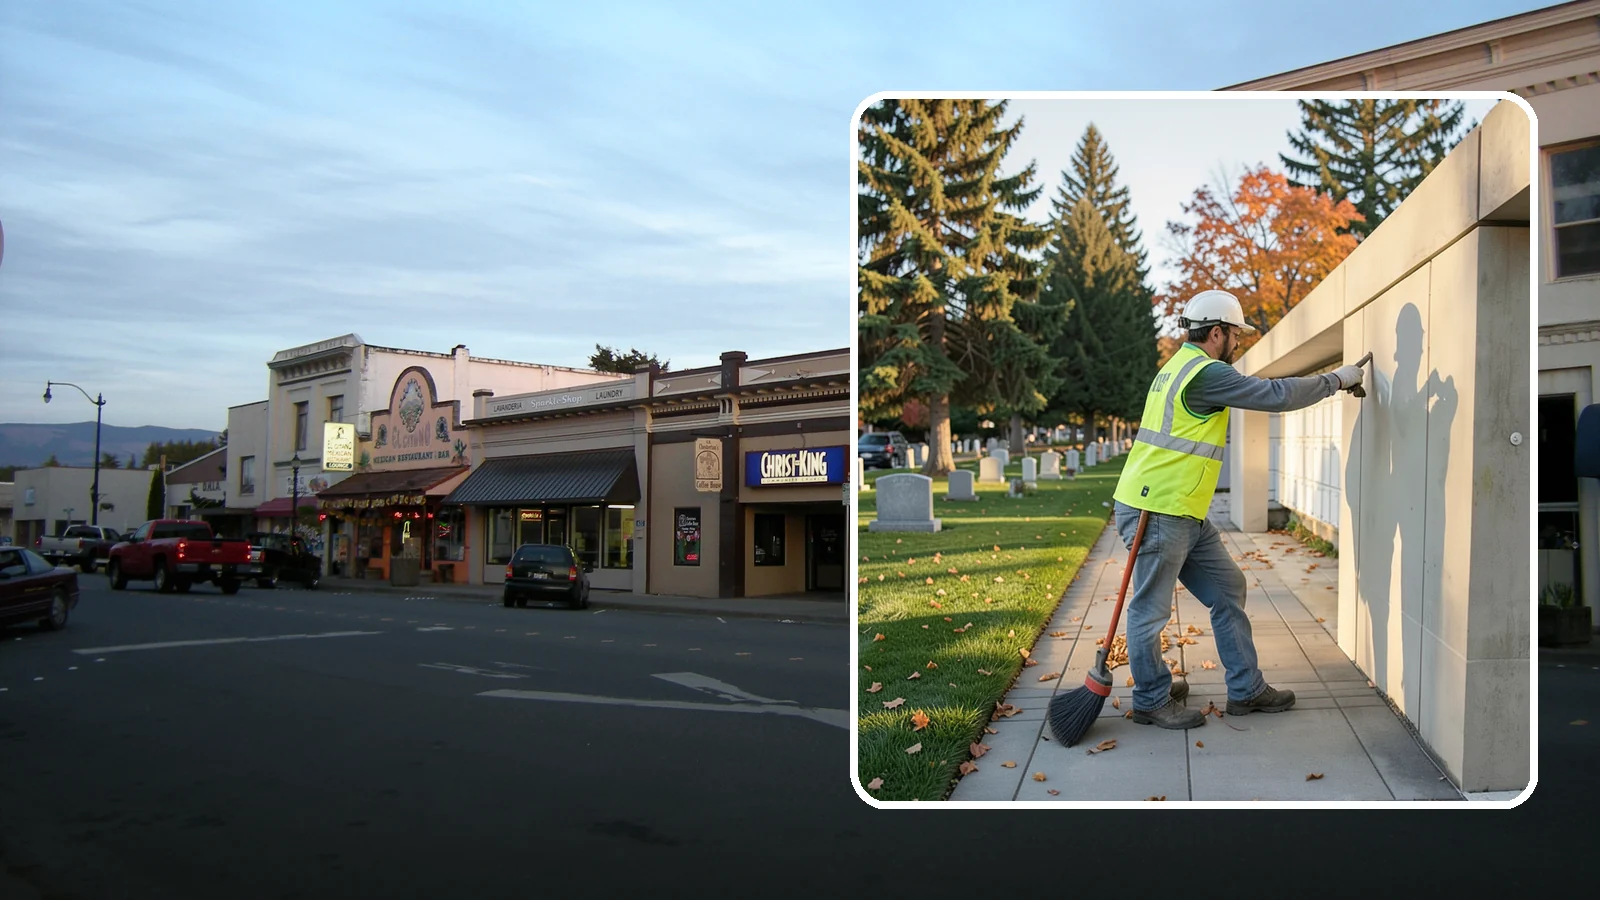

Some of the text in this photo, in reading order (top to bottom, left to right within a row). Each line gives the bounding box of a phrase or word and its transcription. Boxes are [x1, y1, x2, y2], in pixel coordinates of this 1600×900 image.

[493, 389, 623, 412] LAVANDERIA Sparkle Shop LAUNDRY
[373, 450, 450, 464] MEXICAN RESTAURANT BAR
[761, 450, 827, 478] CHRIST KING
